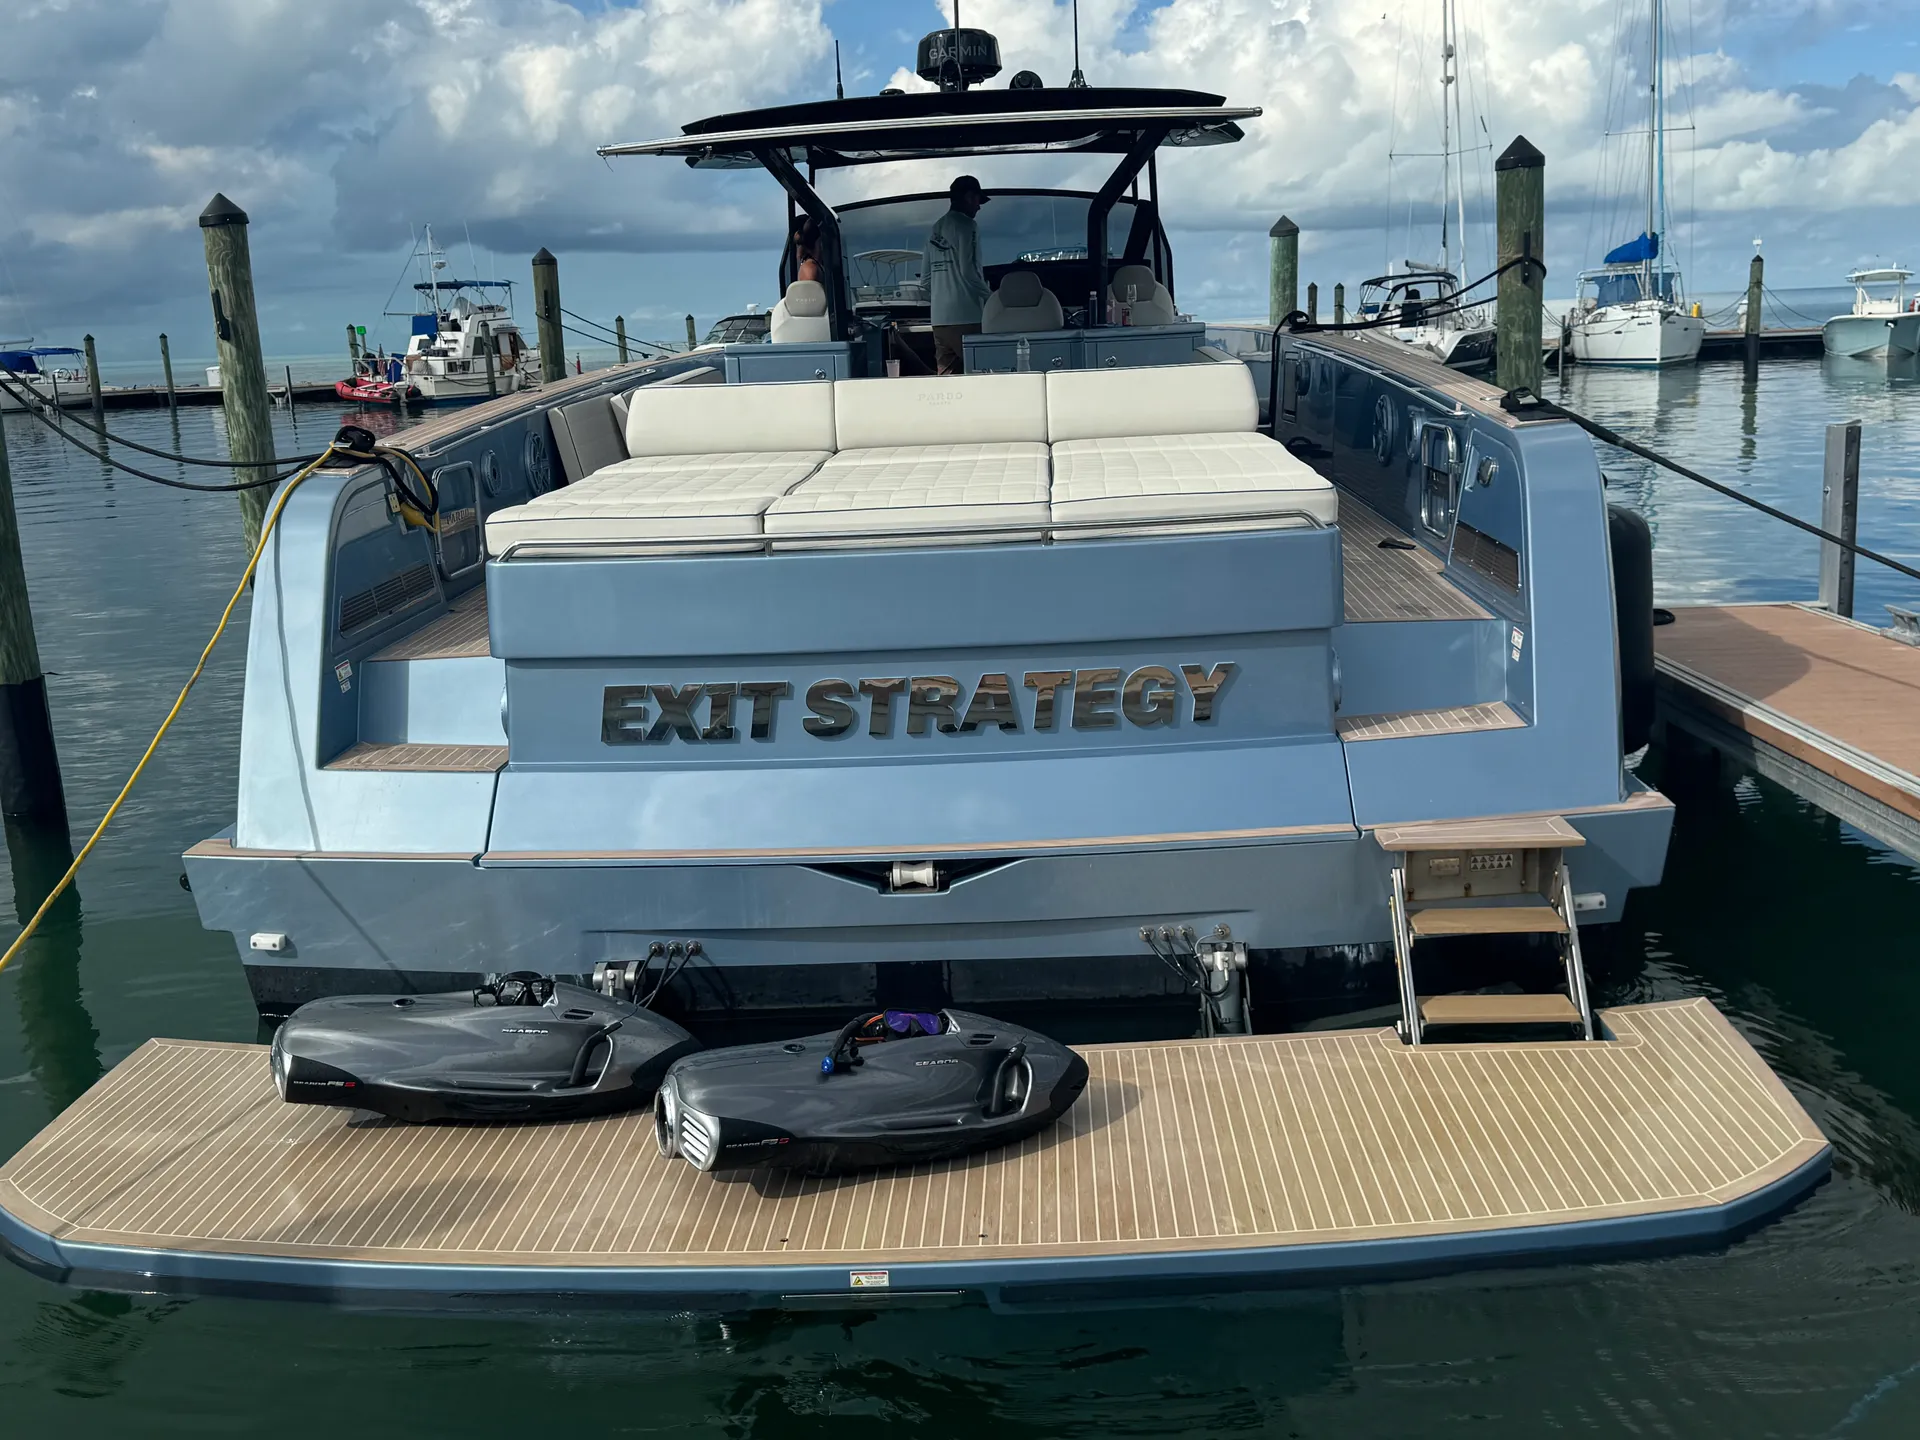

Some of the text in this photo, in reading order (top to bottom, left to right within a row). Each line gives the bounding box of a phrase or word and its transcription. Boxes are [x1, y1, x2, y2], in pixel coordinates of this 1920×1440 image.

[918, 392, 963, 402] PARDO
[601, 661, 1236, 743] EXIT STRATEGY
